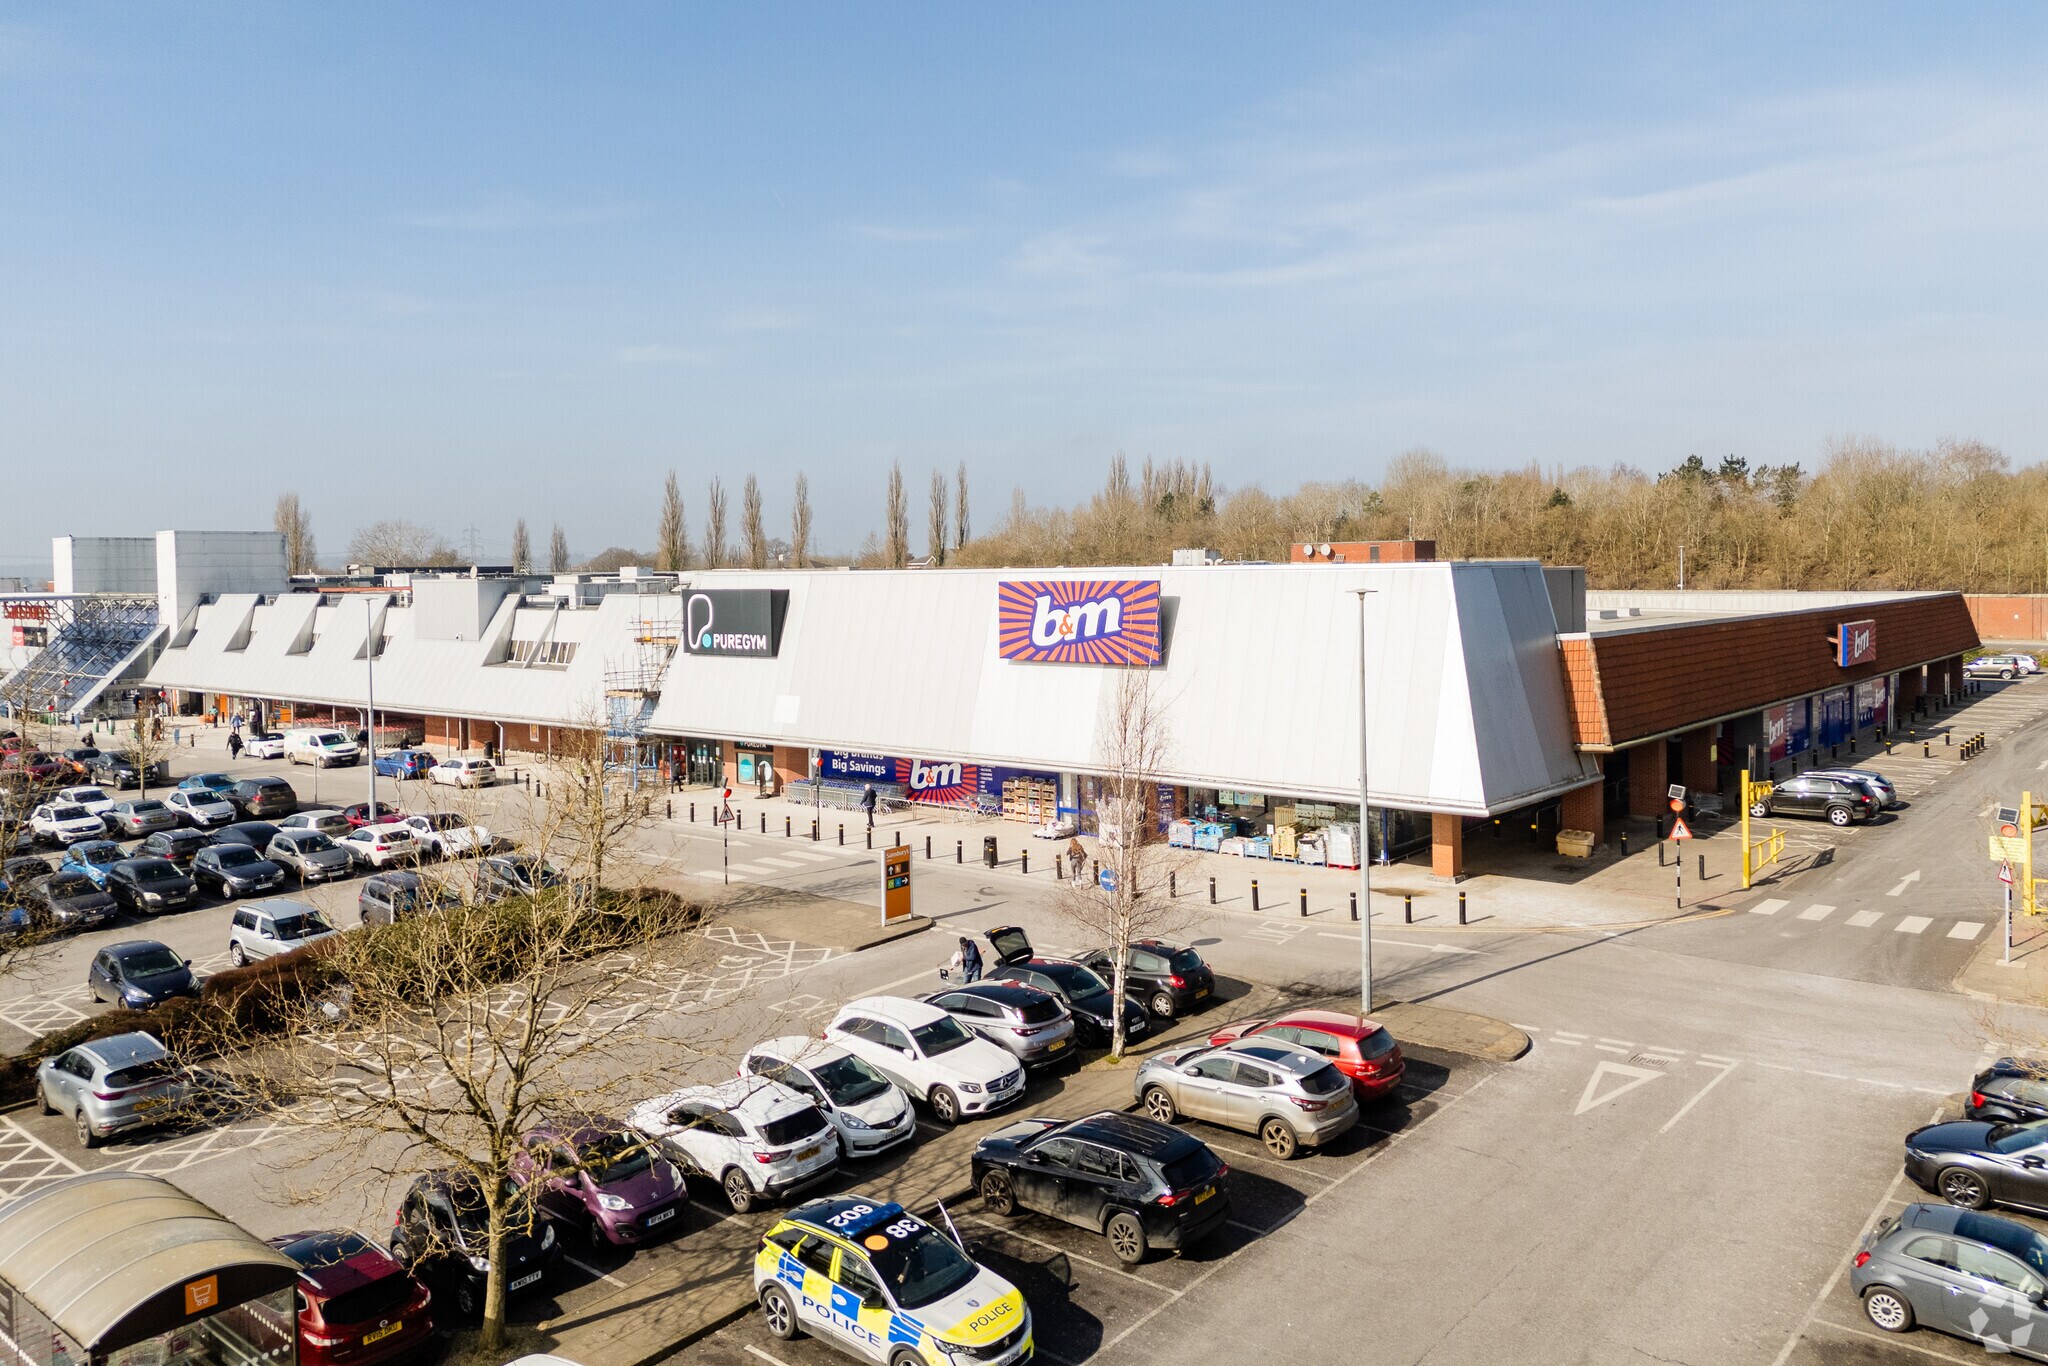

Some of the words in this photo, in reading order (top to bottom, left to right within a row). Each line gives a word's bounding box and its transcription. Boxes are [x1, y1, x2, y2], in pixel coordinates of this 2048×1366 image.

[1031, 595, 1122, 646] b&m
[713, 633, 767, 650] PUREGYM
[832, 758, 848, 773] Big
[849, 760, 886, 777] Savings
[910, 758, 962, 789] b&m
[886, 848, 909, 859] Sainsbury's
[826, 1204, 874, 1227] 602
[885, 1219, 920, 1239] 38
[802, 1295, 881, 1349] POLICE
[969, 1302, 1013, 1332] POLICE
